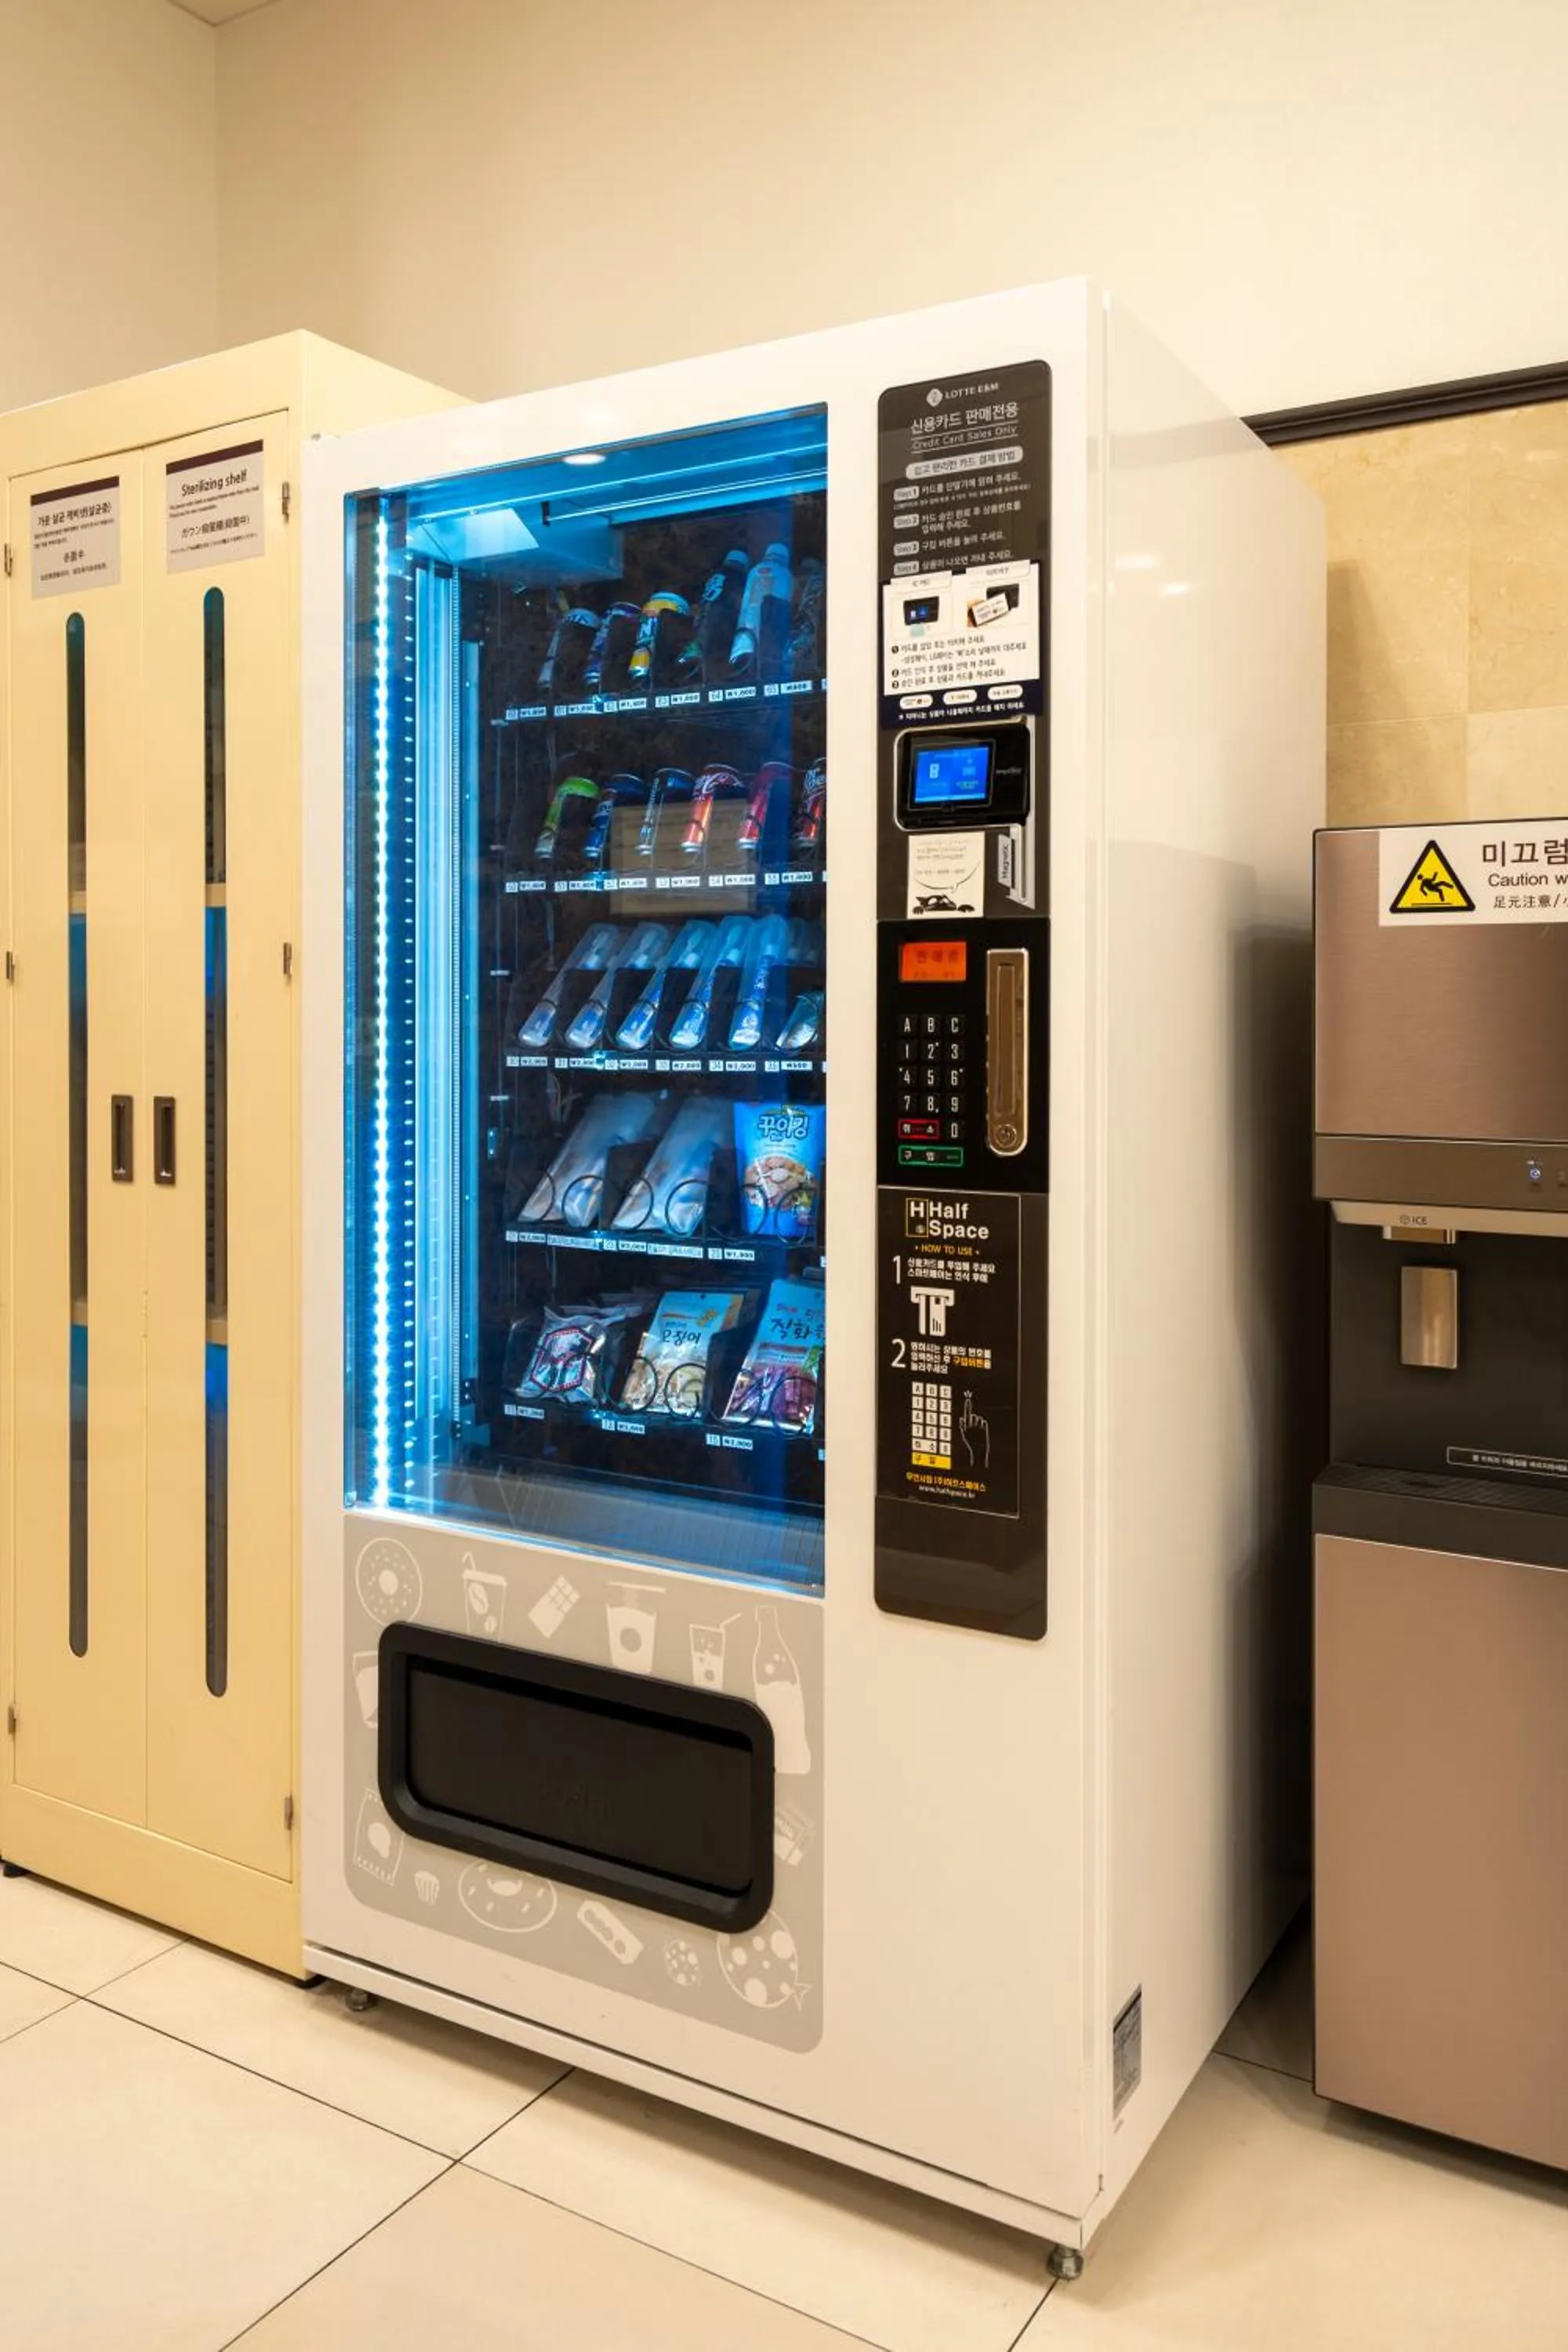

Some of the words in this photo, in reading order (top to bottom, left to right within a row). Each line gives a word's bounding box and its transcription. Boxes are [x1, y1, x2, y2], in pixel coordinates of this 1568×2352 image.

[945, 387, 975, 399] LOTTE
[911, 412, 963, 435] 신용카드
[965, 401, 1018, 425] 판매전용
[913, 439, 940, 450] Credit
[943, 434, 964, 445] Card
[967, 429, 992, 440] Sales
[995, 424, 1017, 436] Only
[182, 477, 223, 496] Sterilizing
[226, 468, 247, 487] shelf
[38, 514, 52, 527] 가운
[1483, 838, 1568, 867] 미끄럼
[1488, 873, 1548, 887] Caution
[905, 1018, 910, 1033] A
[927, 1018, 935, 1033] B
[951, 1018, 958, 1033] C
[905, 1044, 909, 1058] 1
[927, 1044, 935, 1059] 2
[951, 1044, 958, 1059] 3
[903, 1069, 910, 1084] 4
[927, 1069, 934, 1085] 5
[951, 1071, 958, 1086] 6
[903, 1096, 910, 1110] 7
[927, 1096, 934, 1112] 8
[951, 1096, 958, 1112] 9
[951, 1123, 958, 1138] 0
[909, 1201, 924, 1218] H
[928, 1201, 969, 1220] Half
[1412, 1215, 1427, 1225] ICE
[928, 1220, 989, 1239] Space
[921, 1243, 941, 1253] HOW
[943, 1246, 954, 1254] TO
[958, 1247, 972, 1256] USE
[892, 1255, 901, 1284] 1
[891, 1338, 906, 1367] 2
